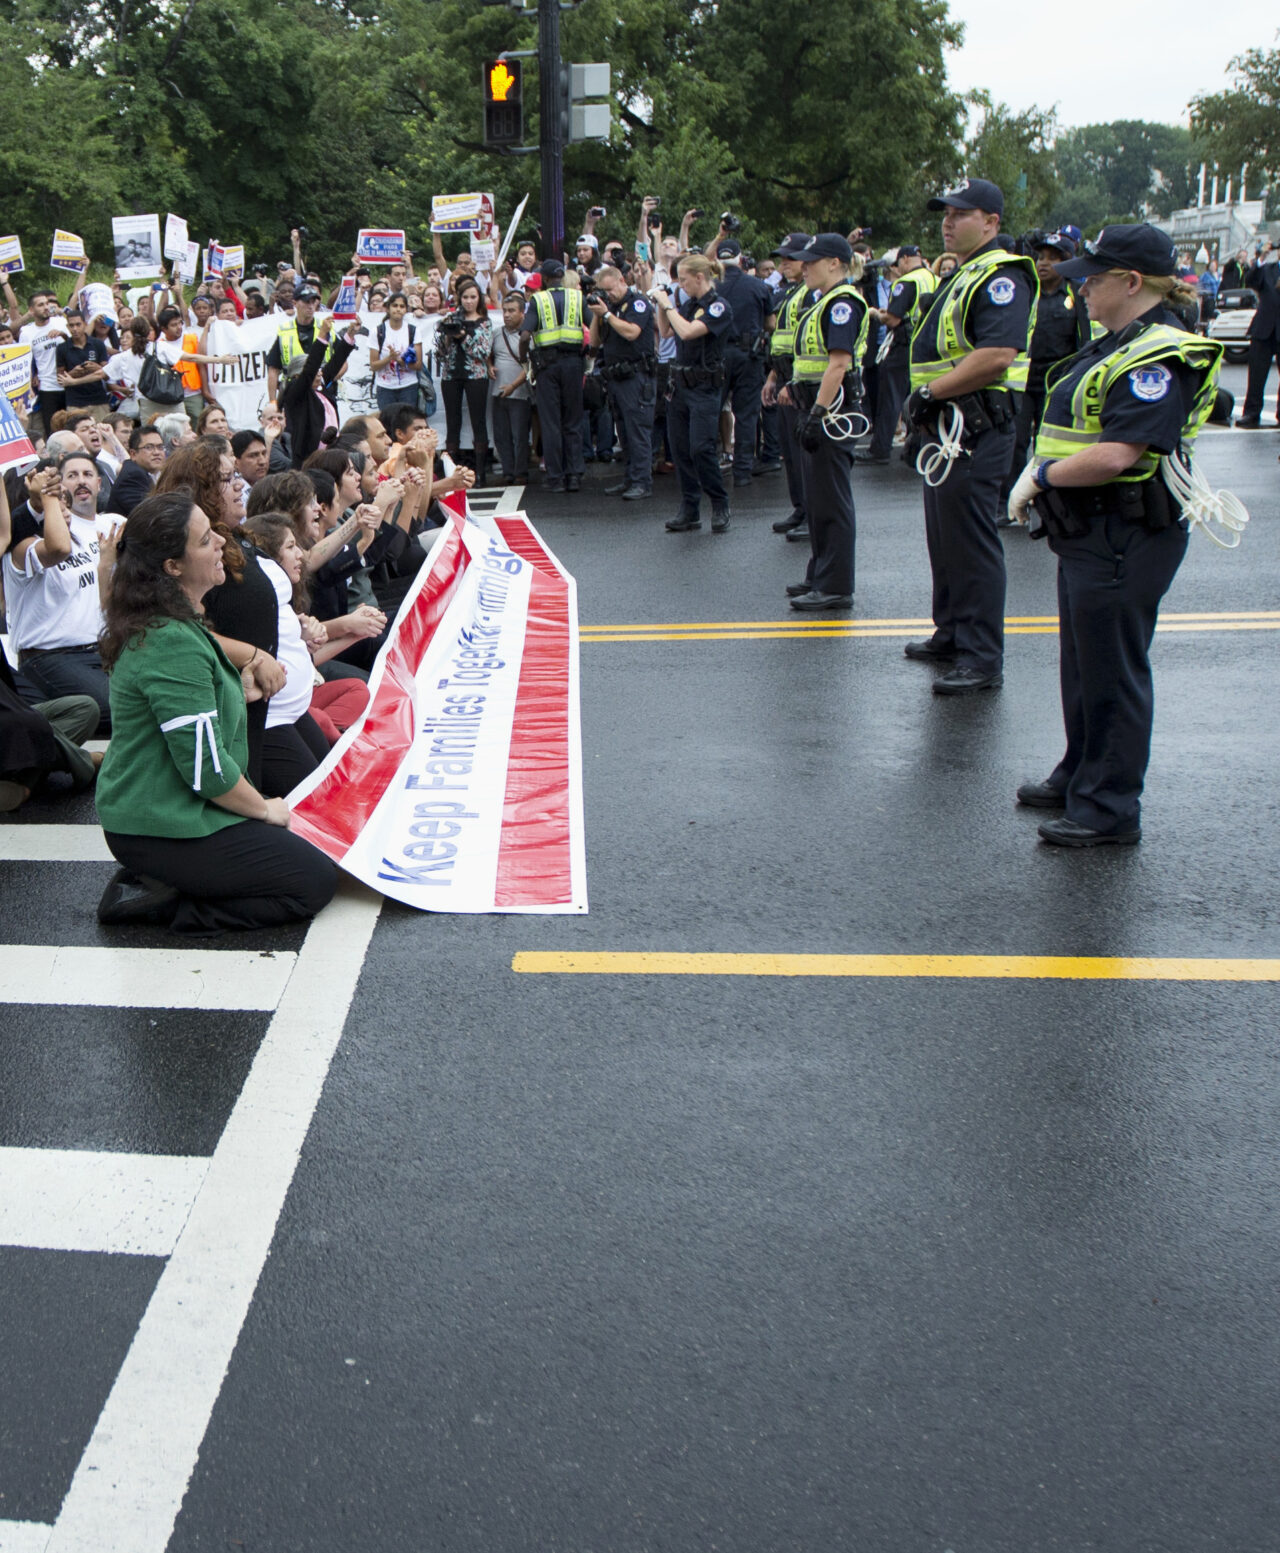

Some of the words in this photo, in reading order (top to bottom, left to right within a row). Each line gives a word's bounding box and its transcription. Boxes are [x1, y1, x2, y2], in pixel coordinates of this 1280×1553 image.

[437, 621, 506, 690] Together
[404, 694, 487, 791] Families
[376, 801, 480, 887] Keep
